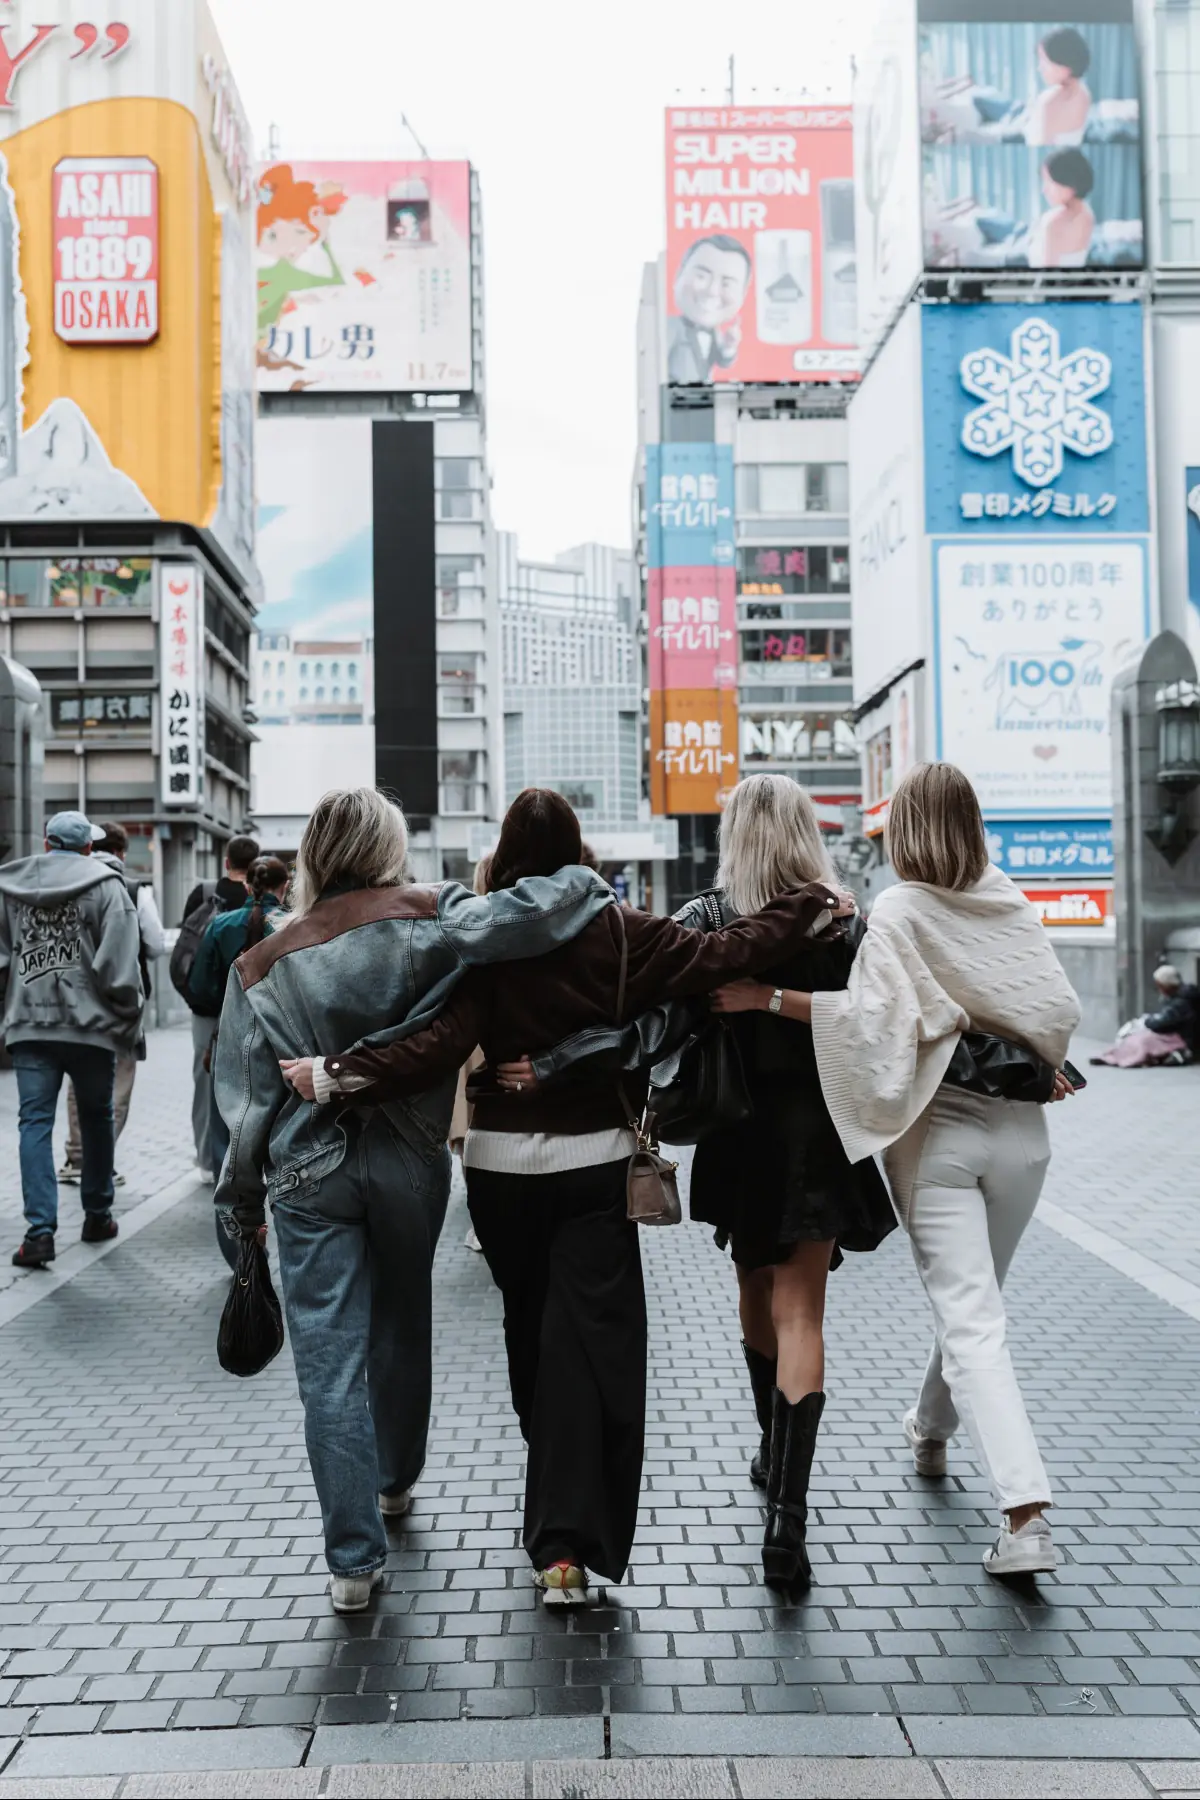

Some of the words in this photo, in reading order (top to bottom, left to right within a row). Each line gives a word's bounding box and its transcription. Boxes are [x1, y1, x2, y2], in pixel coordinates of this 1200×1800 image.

[673, 134, 797, 164] SUPER
[56, 173, 153, 219] ASAHI
[673, 167, 811, 196] MILLION
[674, 201, 768, 230] HAIR
[57, 235, 153, 281] 1889
[61, 289, 151, 330] OSAKA
[959, 488, 1118, 518] 雪印メグミルク
[960, 562, 1123, 588] 創業100周年
[982, 597, 1105, 622] ありがとう
[1010, 660, 1075, 687] 100
[18, 936, 82, 977] JAPAN!
